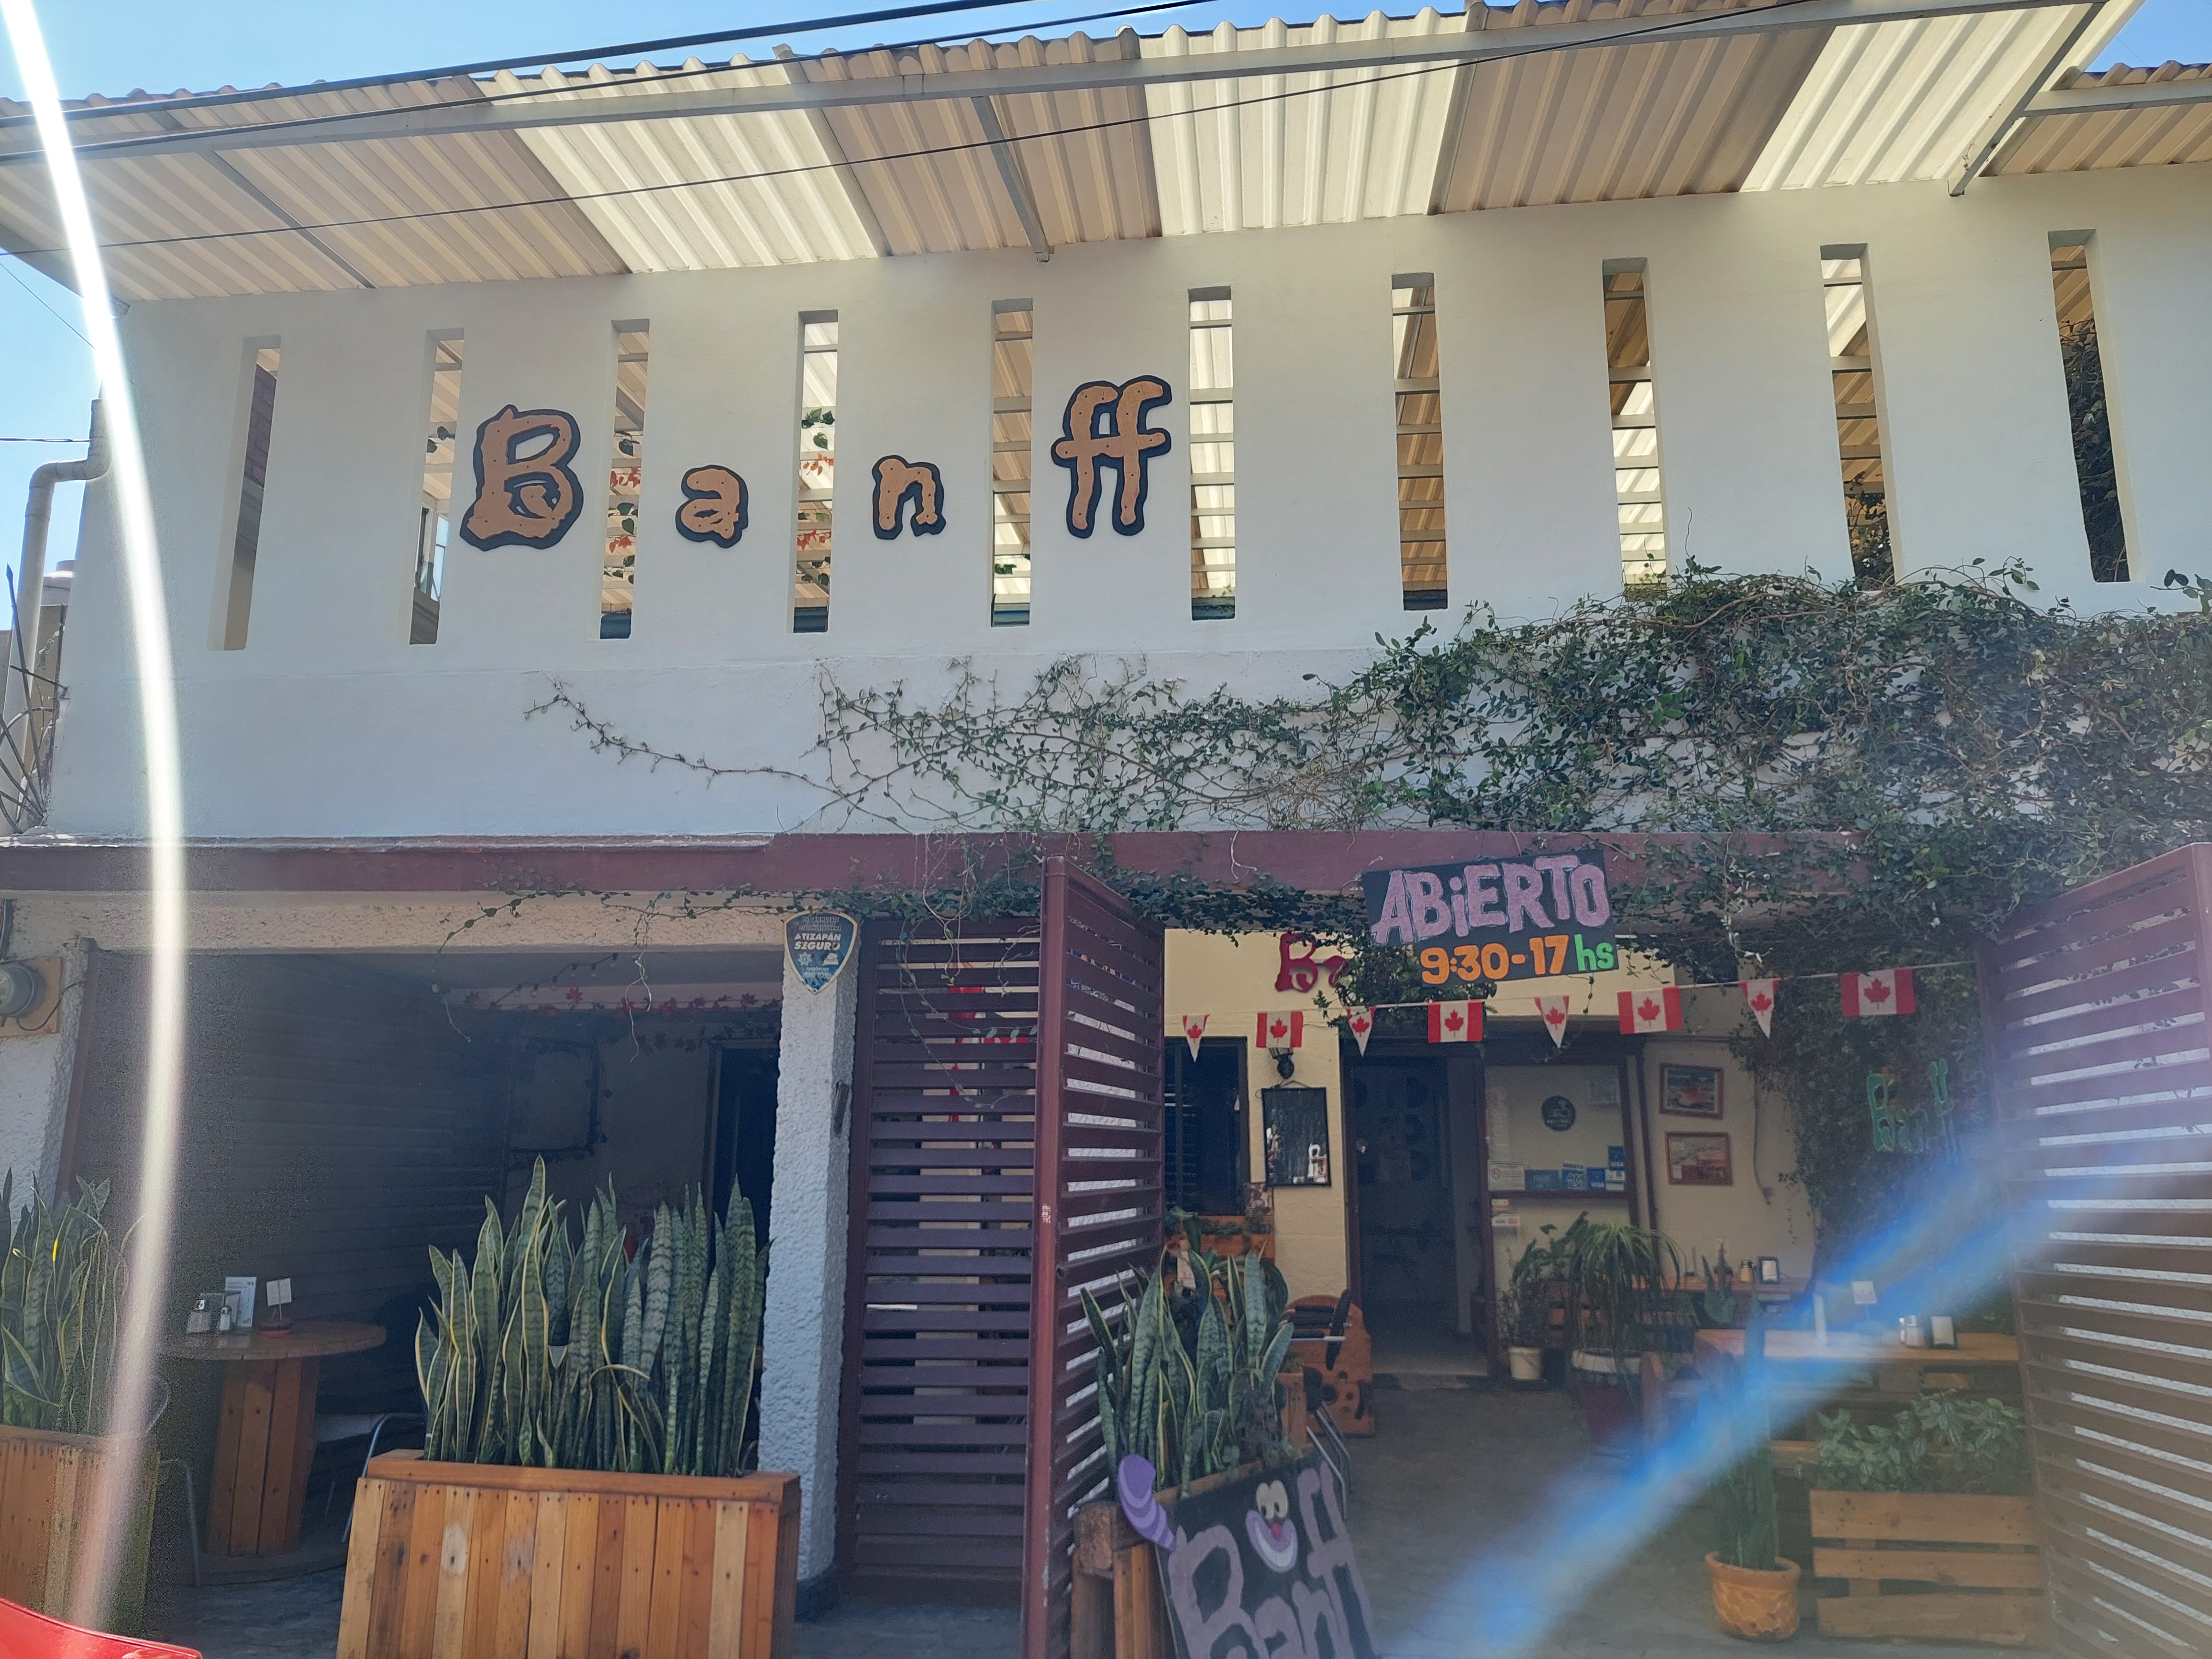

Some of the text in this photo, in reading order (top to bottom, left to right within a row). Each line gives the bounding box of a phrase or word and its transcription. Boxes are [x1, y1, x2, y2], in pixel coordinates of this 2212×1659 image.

[460, 374, 1173, 551] Banff
[794, 932, 841, 941] ATIZAPÁN
[794, 941, 841, 951] SEGURO
[1574, 934, 1615, 972] hs
[1168, 1459, 1376, 1659] Banff
